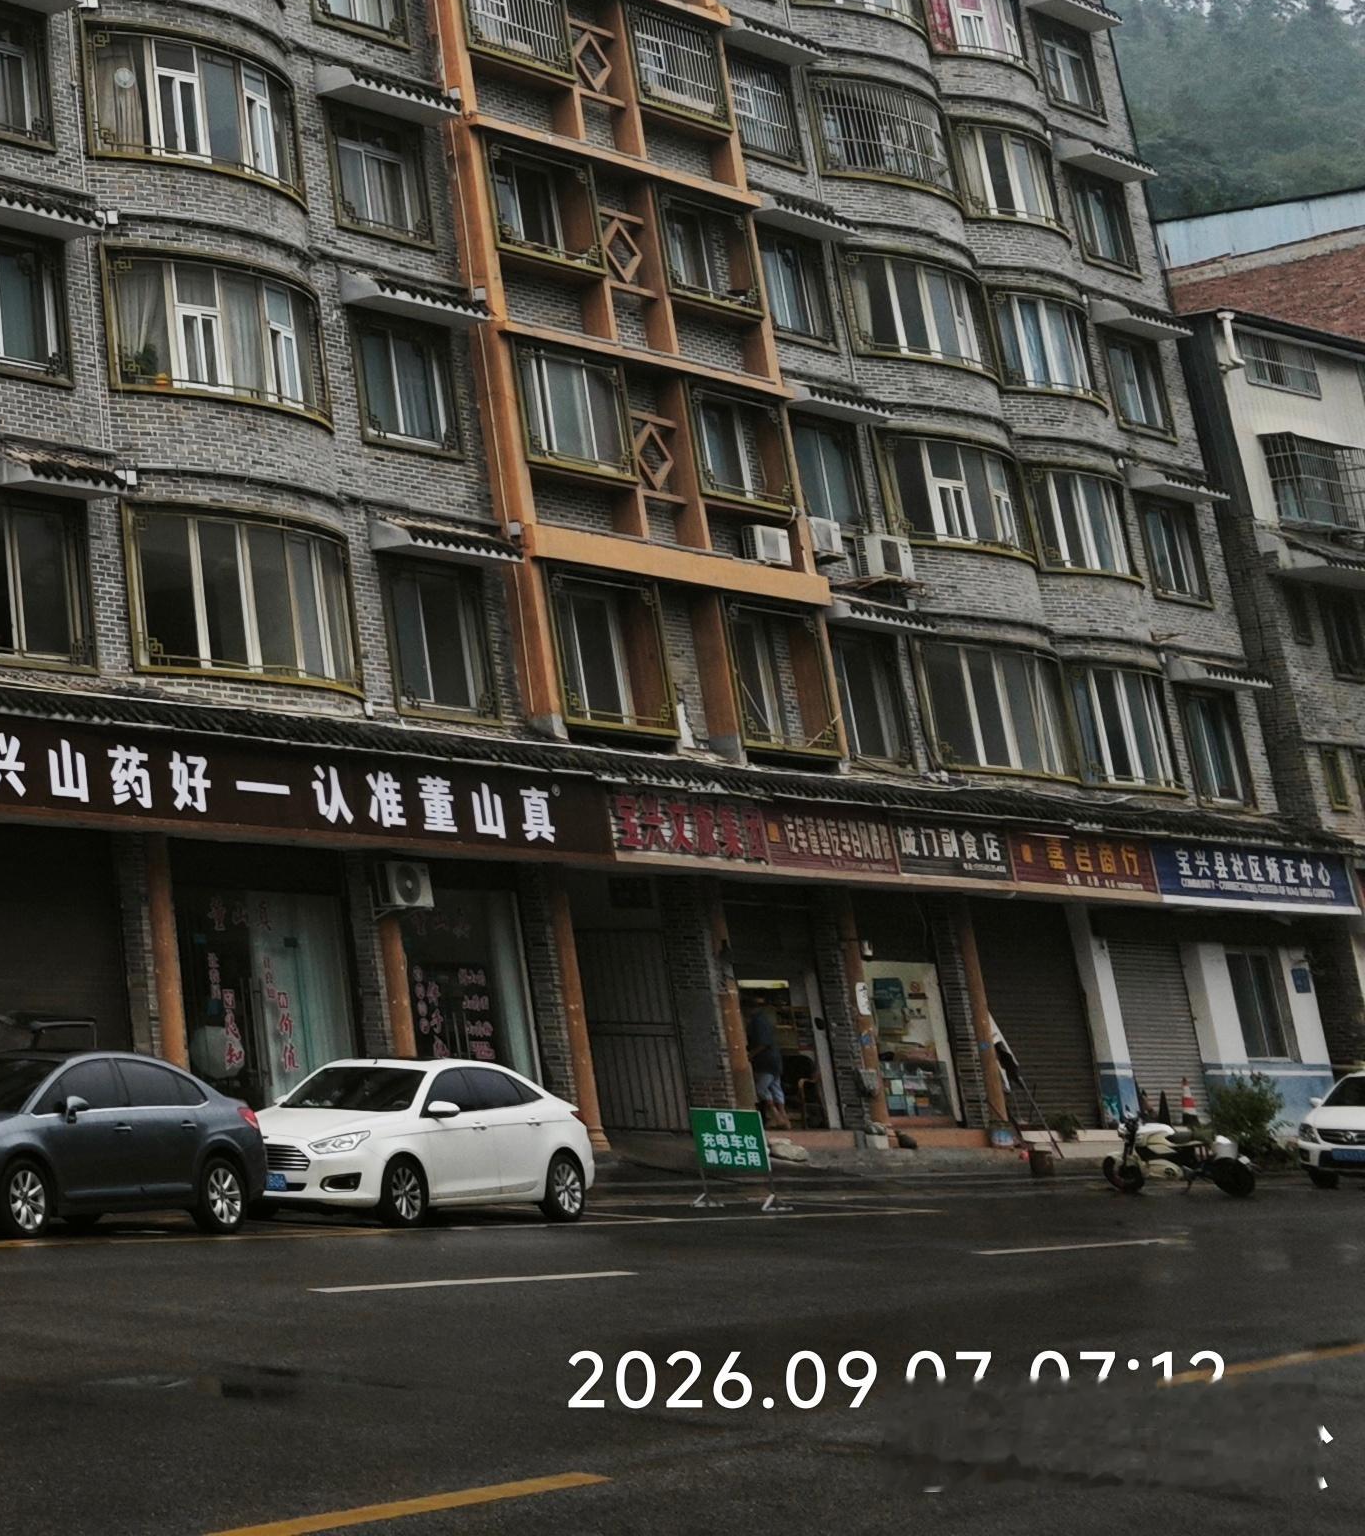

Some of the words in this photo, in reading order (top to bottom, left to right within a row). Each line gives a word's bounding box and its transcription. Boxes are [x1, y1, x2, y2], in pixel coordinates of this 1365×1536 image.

[1174, 848, 1332, 887] 宝兴县社区矫正中心
[701, 1132, 759, 1150] 充电车位
[704, 1149, 762, 1167] 请勿占用
